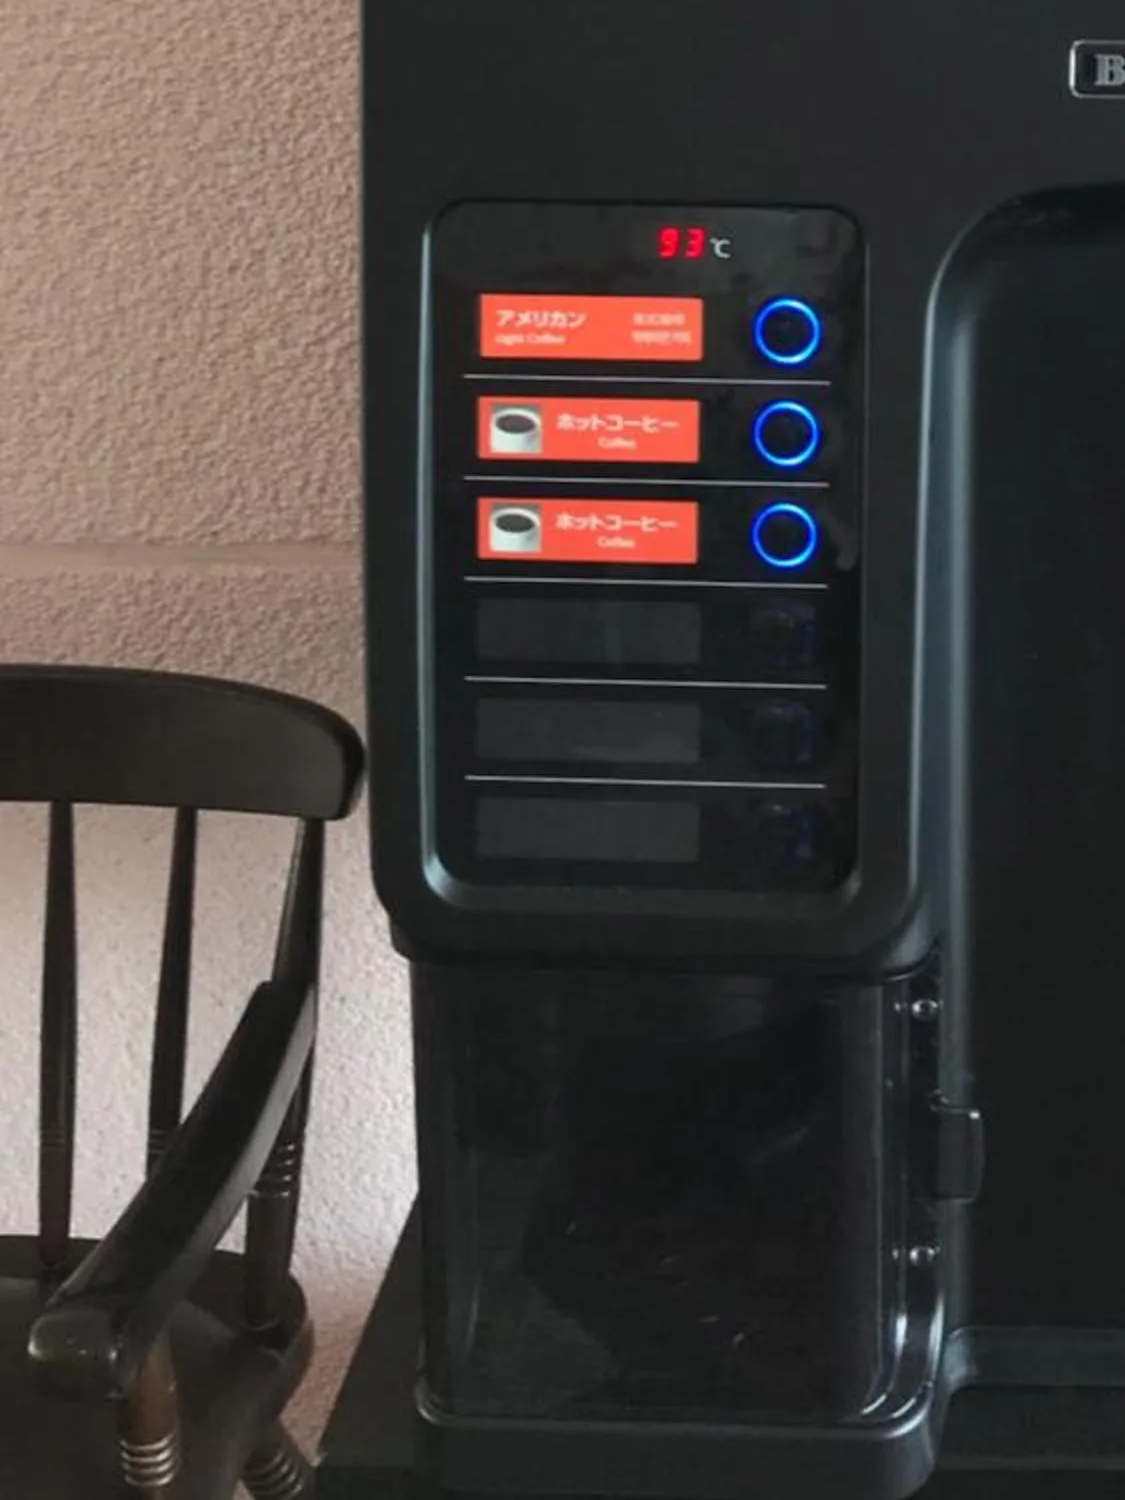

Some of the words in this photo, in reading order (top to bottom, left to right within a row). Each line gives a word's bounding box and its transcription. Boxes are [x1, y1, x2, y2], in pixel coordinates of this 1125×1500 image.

[658, 227, 706, 259] 93
[495, 309, 589, 329] アメリカン
[555, 412, 680, 434] ホットコーヒー
[597, 436, 637, 450] Coffee
[555, 511, 679, 533] ホットコーヒー
[596, 536, 636, 549] Coffee
